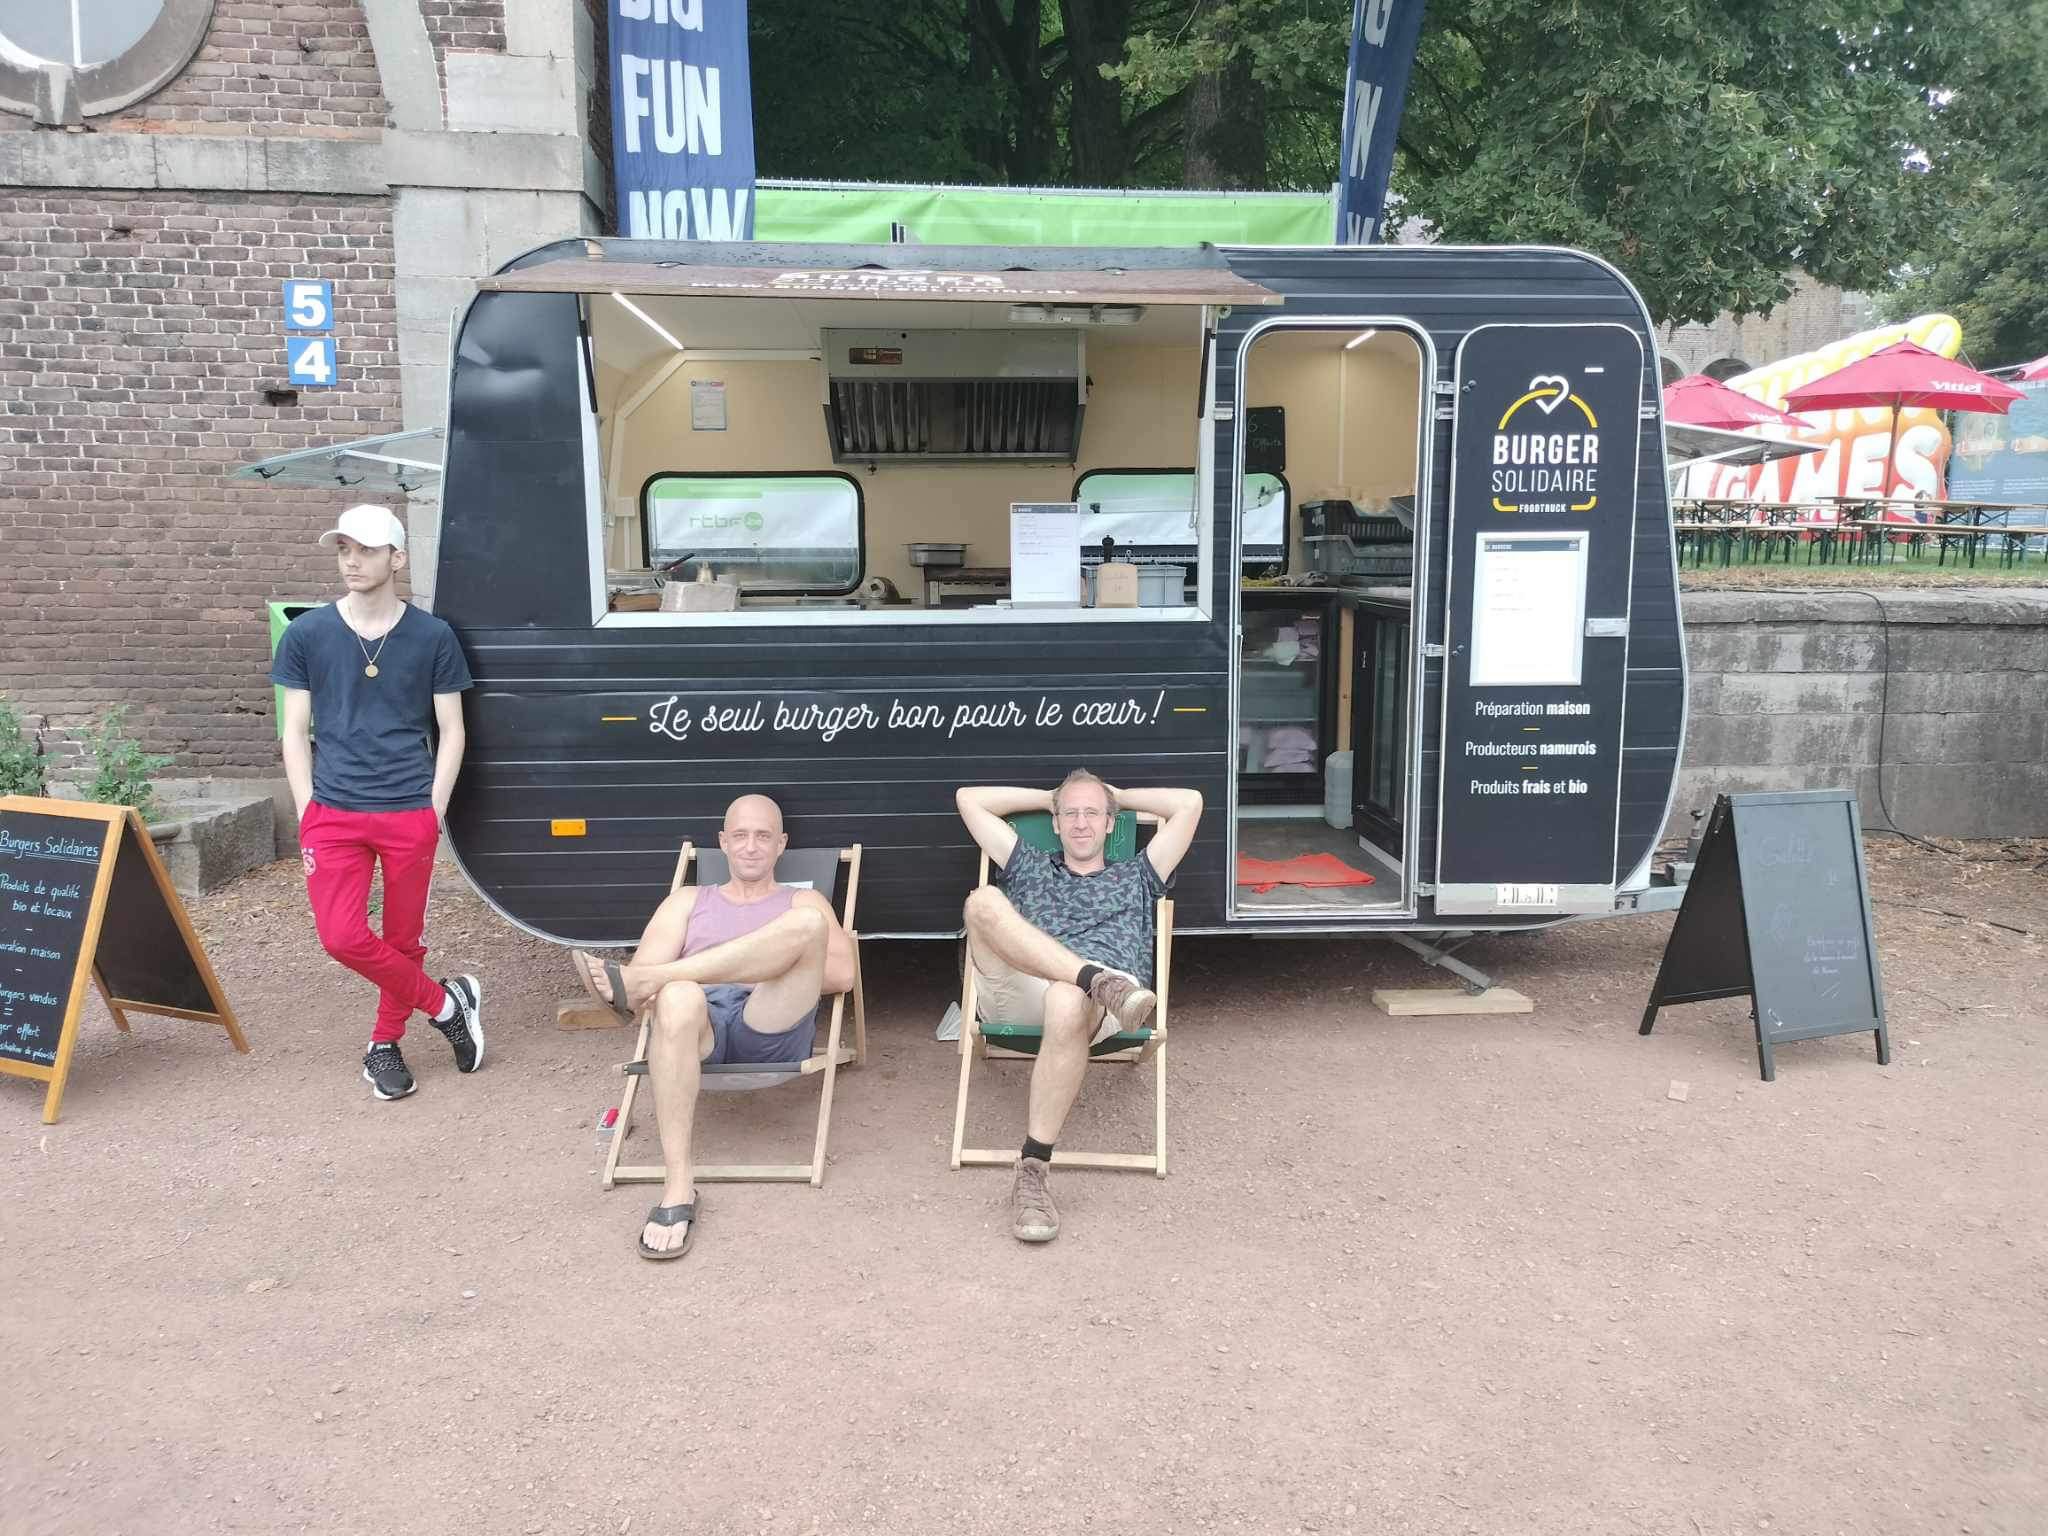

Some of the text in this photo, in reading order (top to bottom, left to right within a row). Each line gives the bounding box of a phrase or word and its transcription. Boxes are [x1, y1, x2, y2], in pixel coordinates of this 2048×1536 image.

[621, 54, 722, 156] FUN
[292, 285, 326, 327] 5
[294, 341, 331, 383] 4
[1931, 381, 1983, 393] Vittel
[1493, 434, 1599, 465] BURGER
[1492, 469, 1597, 493] SOLIDAIRE
[1518, 503, 1567, 513] FOODTRUCK
[649, 696, 691, 741] Le
[701, 700, 764, 732] seul
[773, 700, 879, 742] burger
[888, 698, 945, 729] bon
[948, 701, 1027, 739] pour
[1035, 696, 1063, 727] le
[1475, 700, 1591, 718] Préparation maison
[1465, 740, 1597, 756] Producteurs namurois
[1470, 779, 1589, 795] Produits frais et bio
[0, 830, 100, 859] Burgers Solidaires
[0, 873, 81, 902] Produits de qualité
[12, 899, 73, 919] bio et locaux
[0, 939, 61, 960] aration maison
[0, 984, 58, 1006] urgers vendus
[16, 1022, 41, 1041] offert
